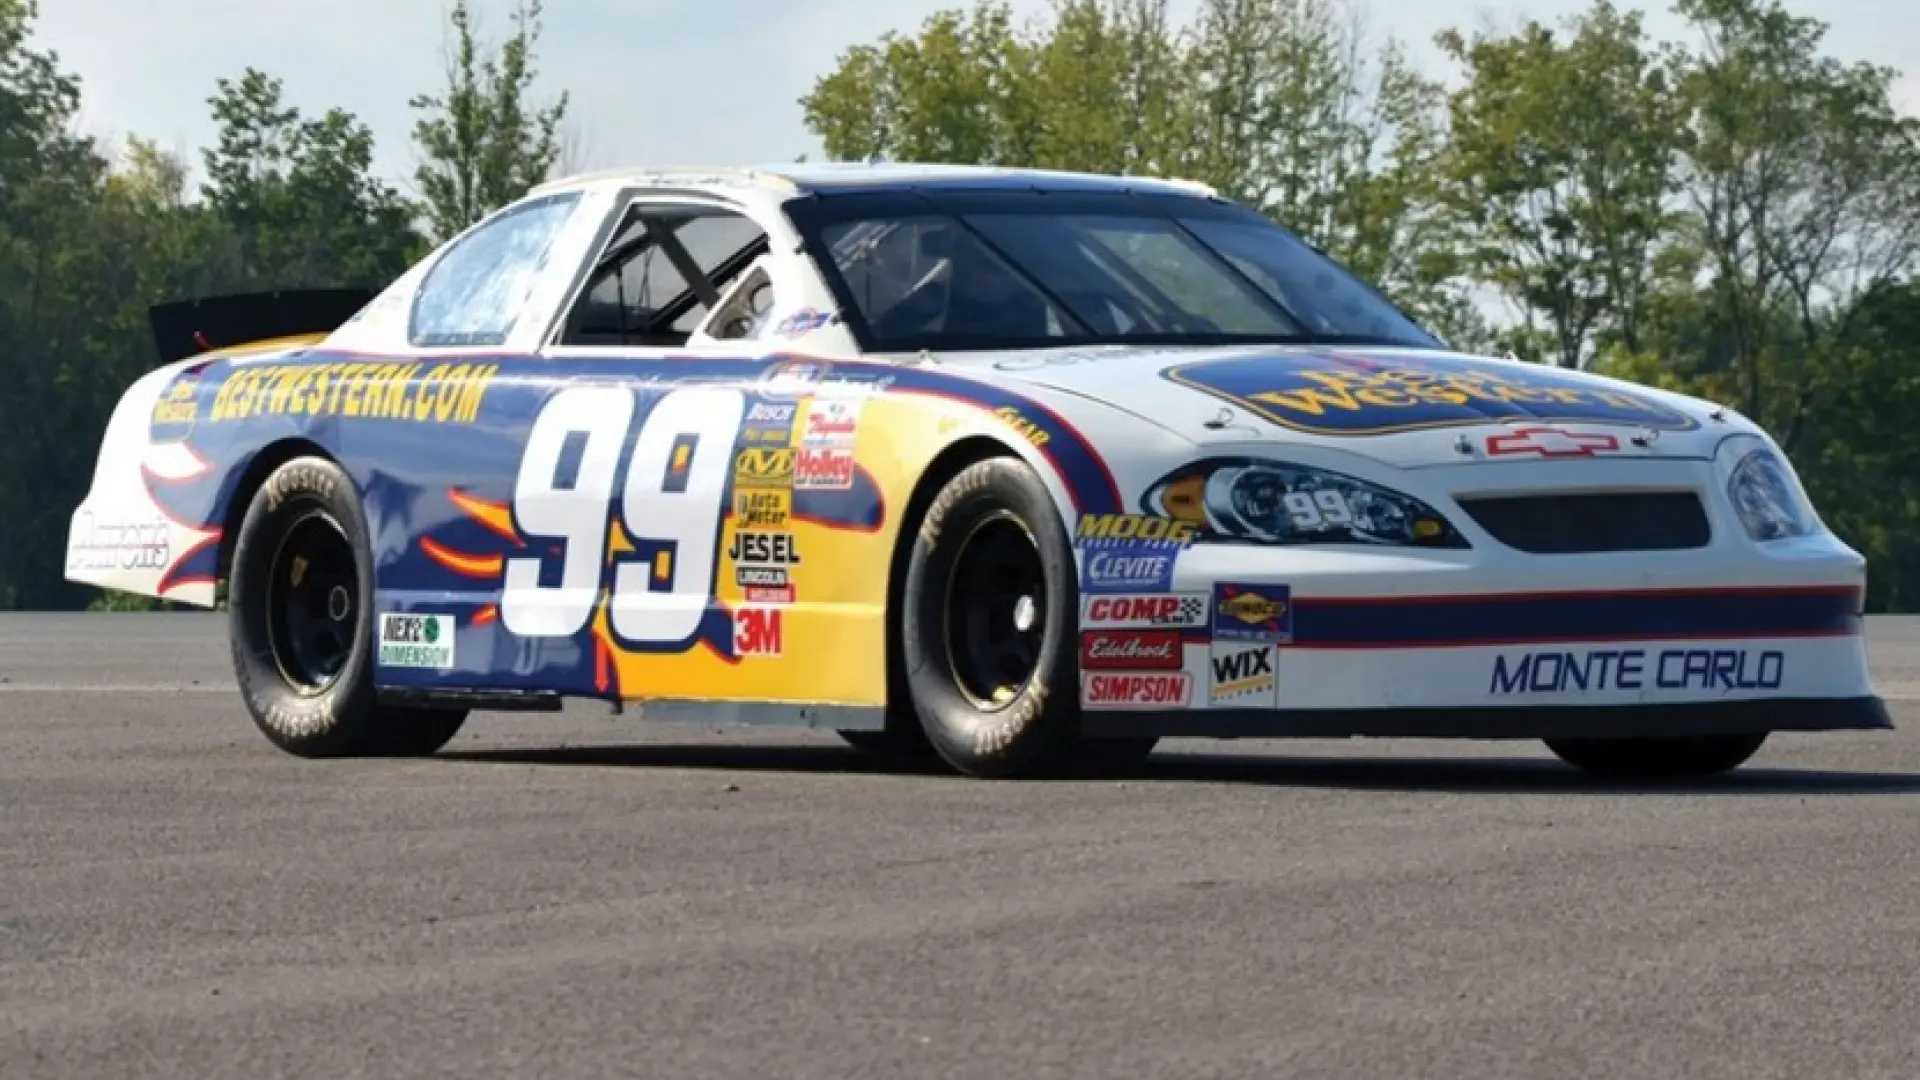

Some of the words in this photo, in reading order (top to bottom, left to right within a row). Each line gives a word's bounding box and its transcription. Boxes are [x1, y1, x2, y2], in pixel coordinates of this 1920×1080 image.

[211, 362, 498, 423] BESTWESTERN.COM
[502, 385, 745, 642] 99
[1284, 488, 1351, 526] 99
[1076, 514, 1198, 544] MOOG
[729, 532, 801, 563] JESEL
[1089, 553, 1168, 581] CLEVITE
[1090, 597, 1179, 621] COMP
[736, 611, 782, 653] 3M
[1089, 635, 1175, 658] Edelbrock
[1212, 647, 1271, 684] WIX
[1490, 650, 1645, 694] MONTE
[1656, 650, 1784, 690] CARLO
[1089, 675, 1184, 702] SIMPSON
